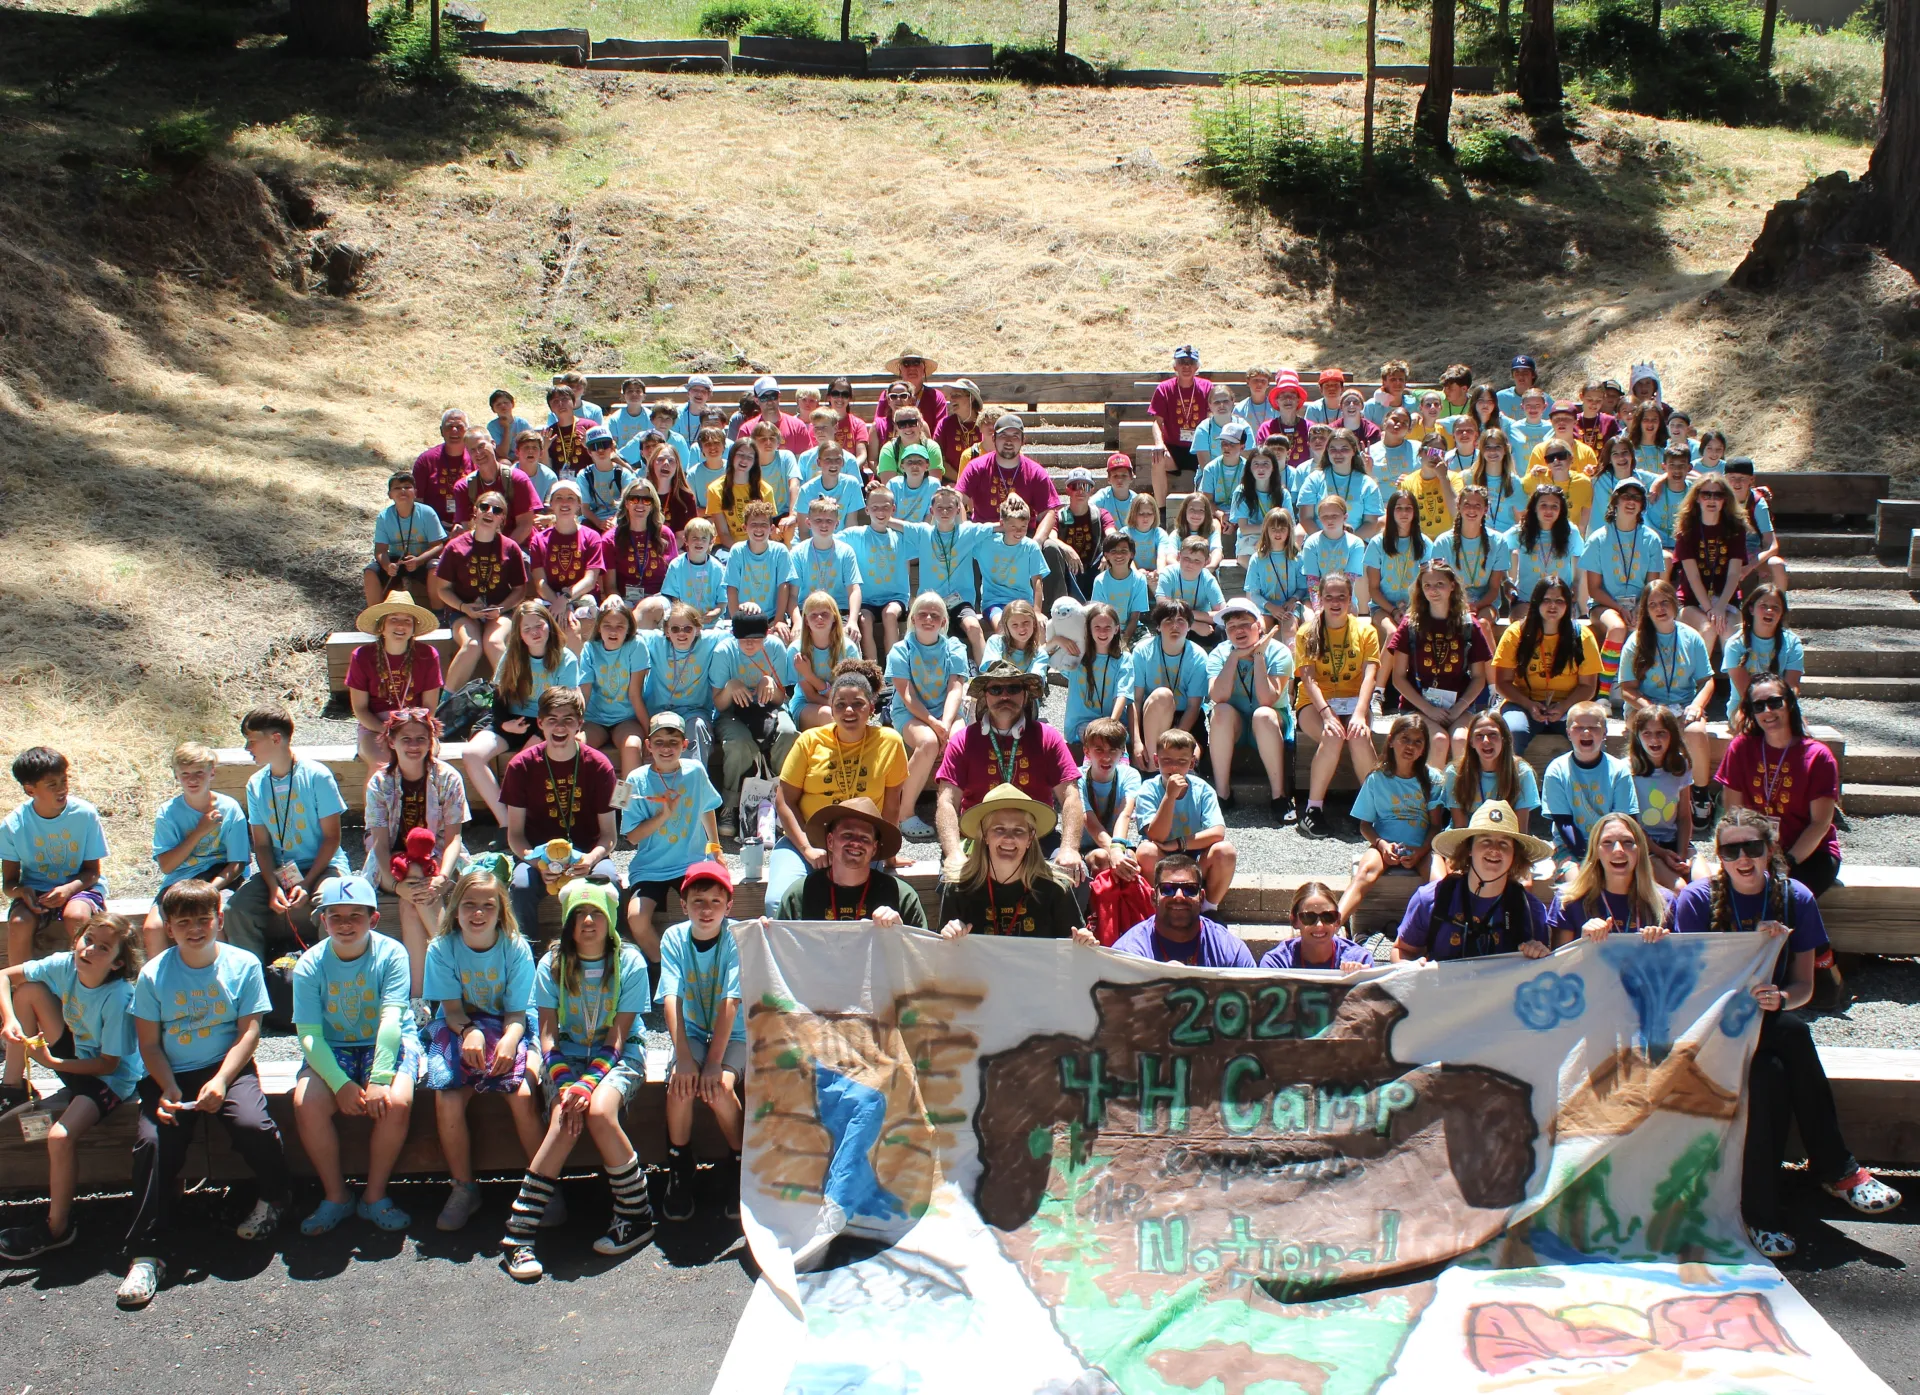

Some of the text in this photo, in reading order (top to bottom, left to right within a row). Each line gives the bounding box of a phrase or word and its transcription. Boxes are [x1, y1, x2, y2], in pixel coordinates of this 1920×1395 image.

[339, 881, 354, 900] K
[1163, 985, 1336, 1046] 2025
[1058, 1051, 1417, 1138] 4-H Camp
[1137, 1209, 1400, 1276] National
